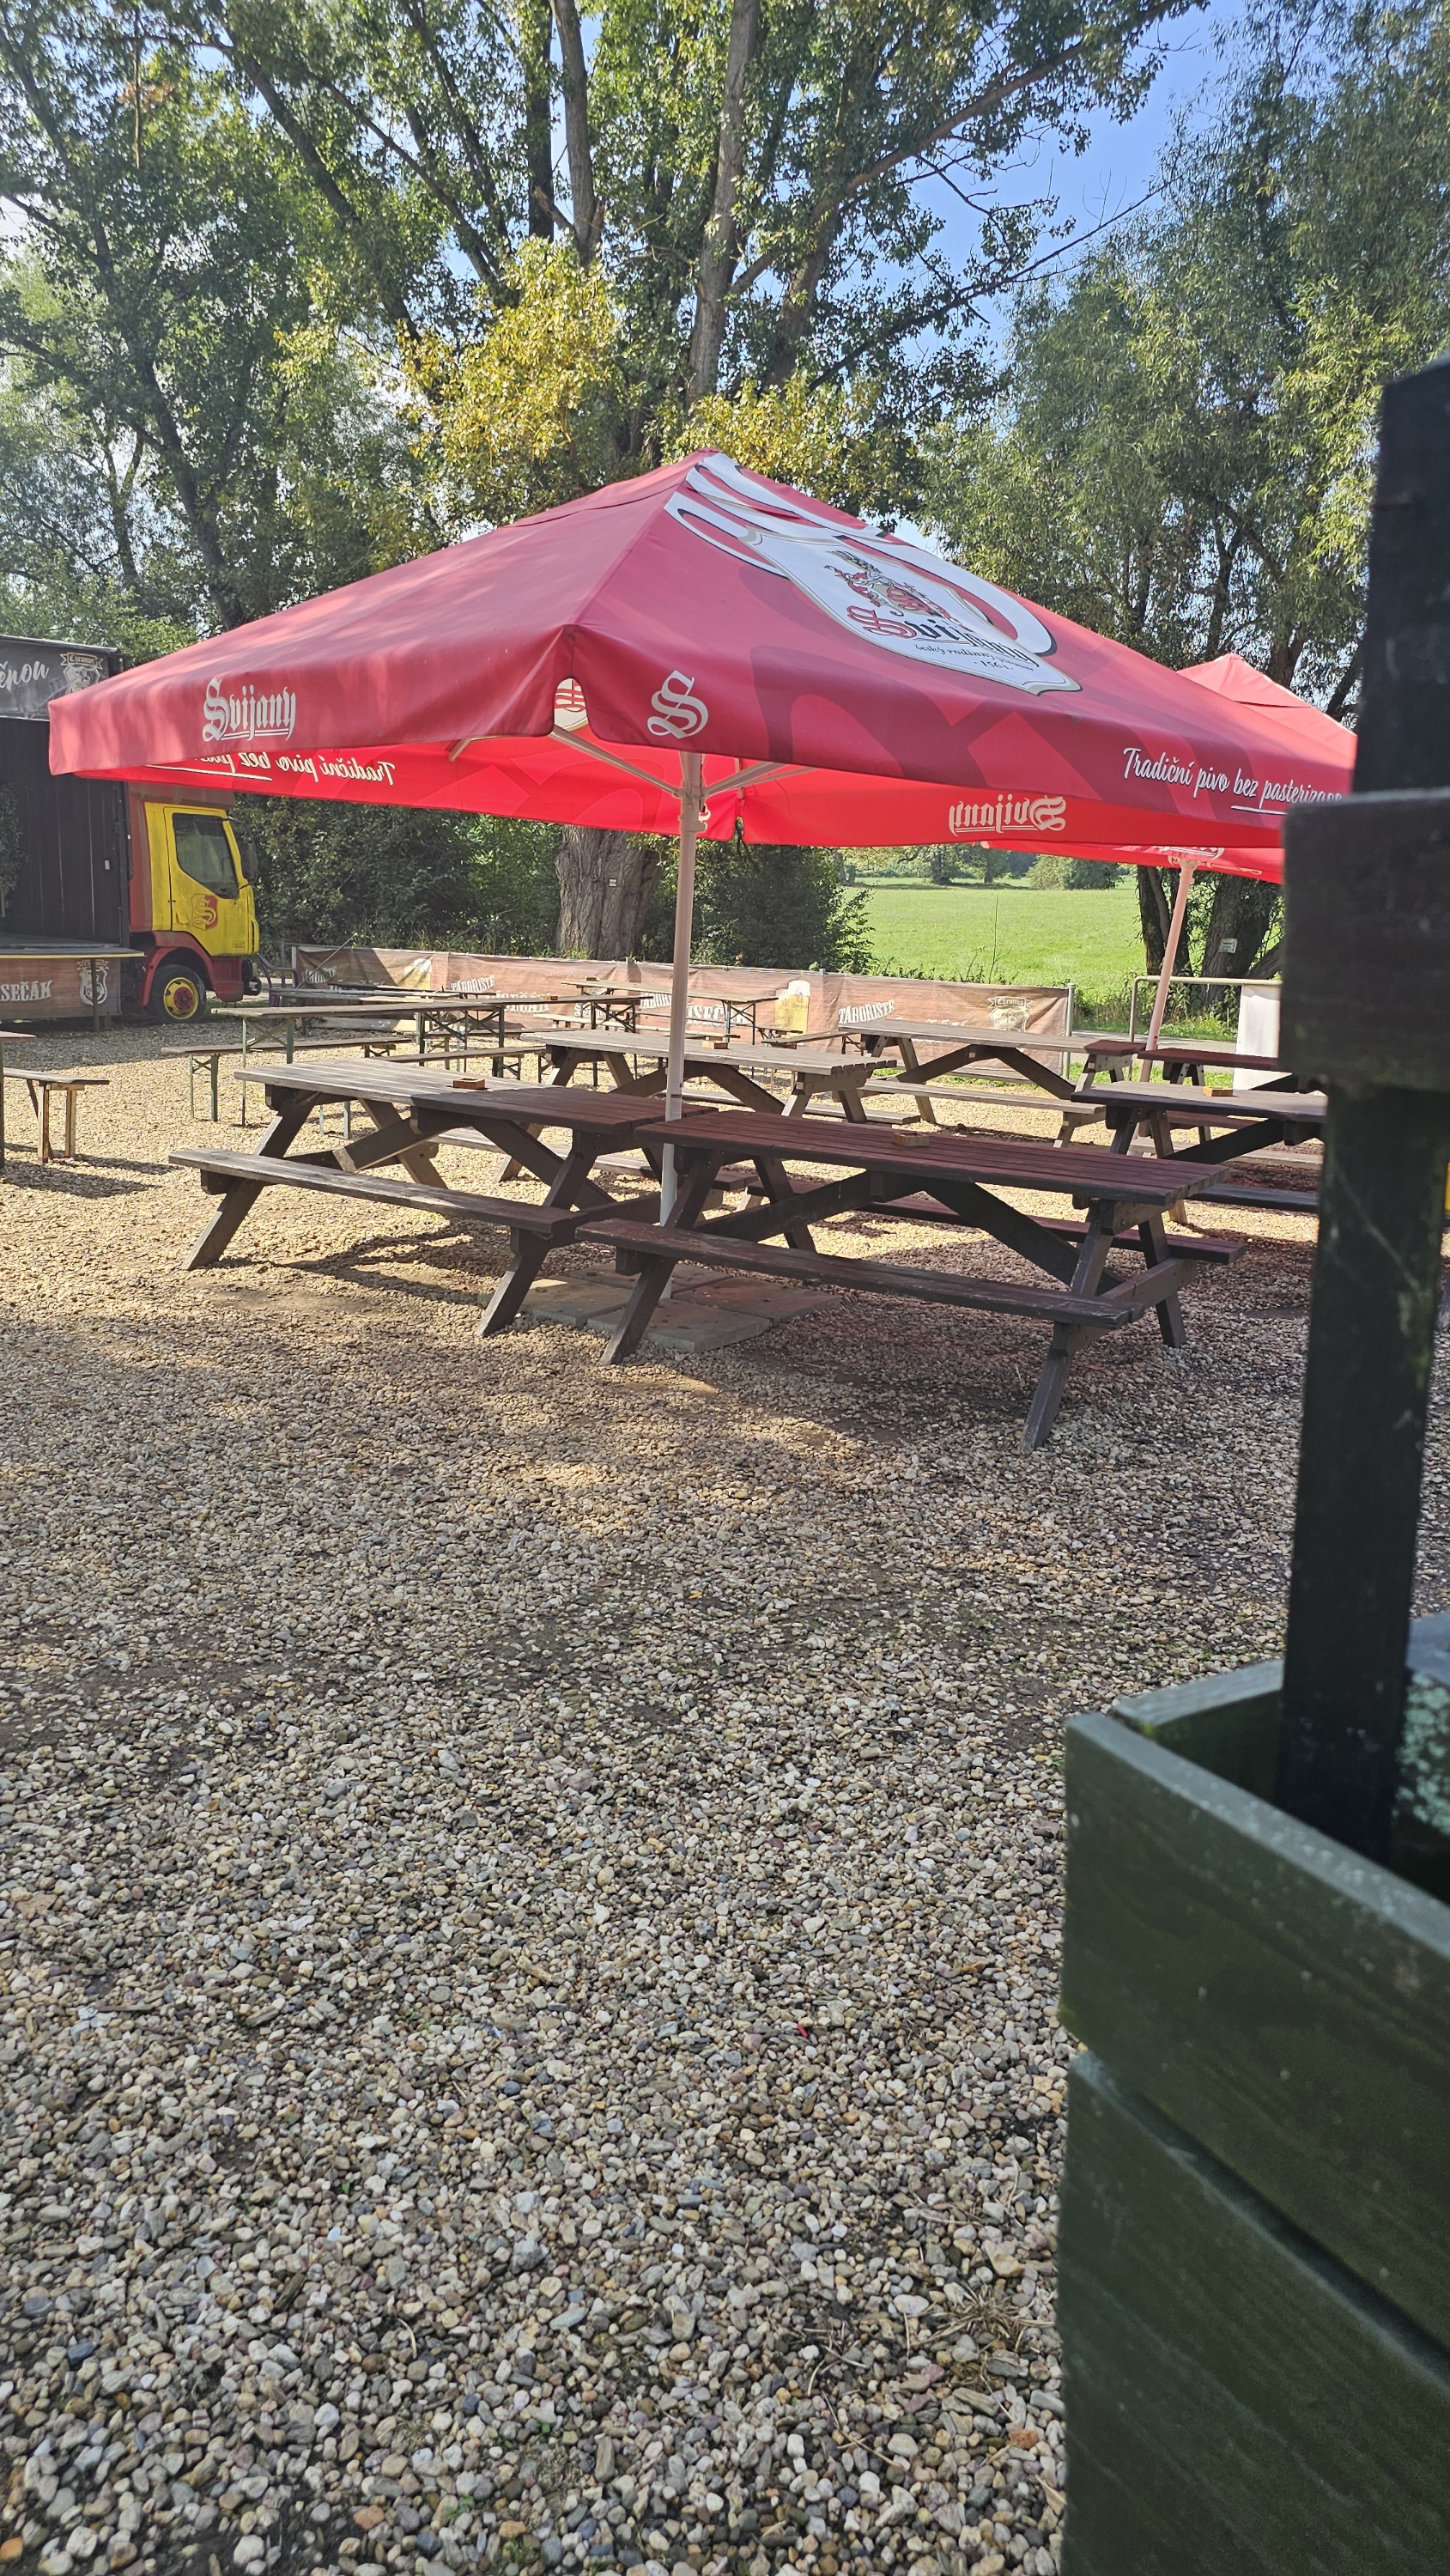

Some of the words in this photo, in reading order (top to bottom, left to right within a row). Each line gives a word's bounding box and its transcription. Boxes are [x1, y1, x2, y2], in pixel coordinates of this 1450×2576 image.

[846, 605, 1040, 668] Svijany
[203, 677, 296, 742] Svijany
[647, 670, 709, 739] S
[1123, 747, 1195, 787] Tradiční
[1193, 767, 1231, 799] pivo
[1233, 768, 1259, 798] bez
[0, 980, 53, 1002] SEČÁK
